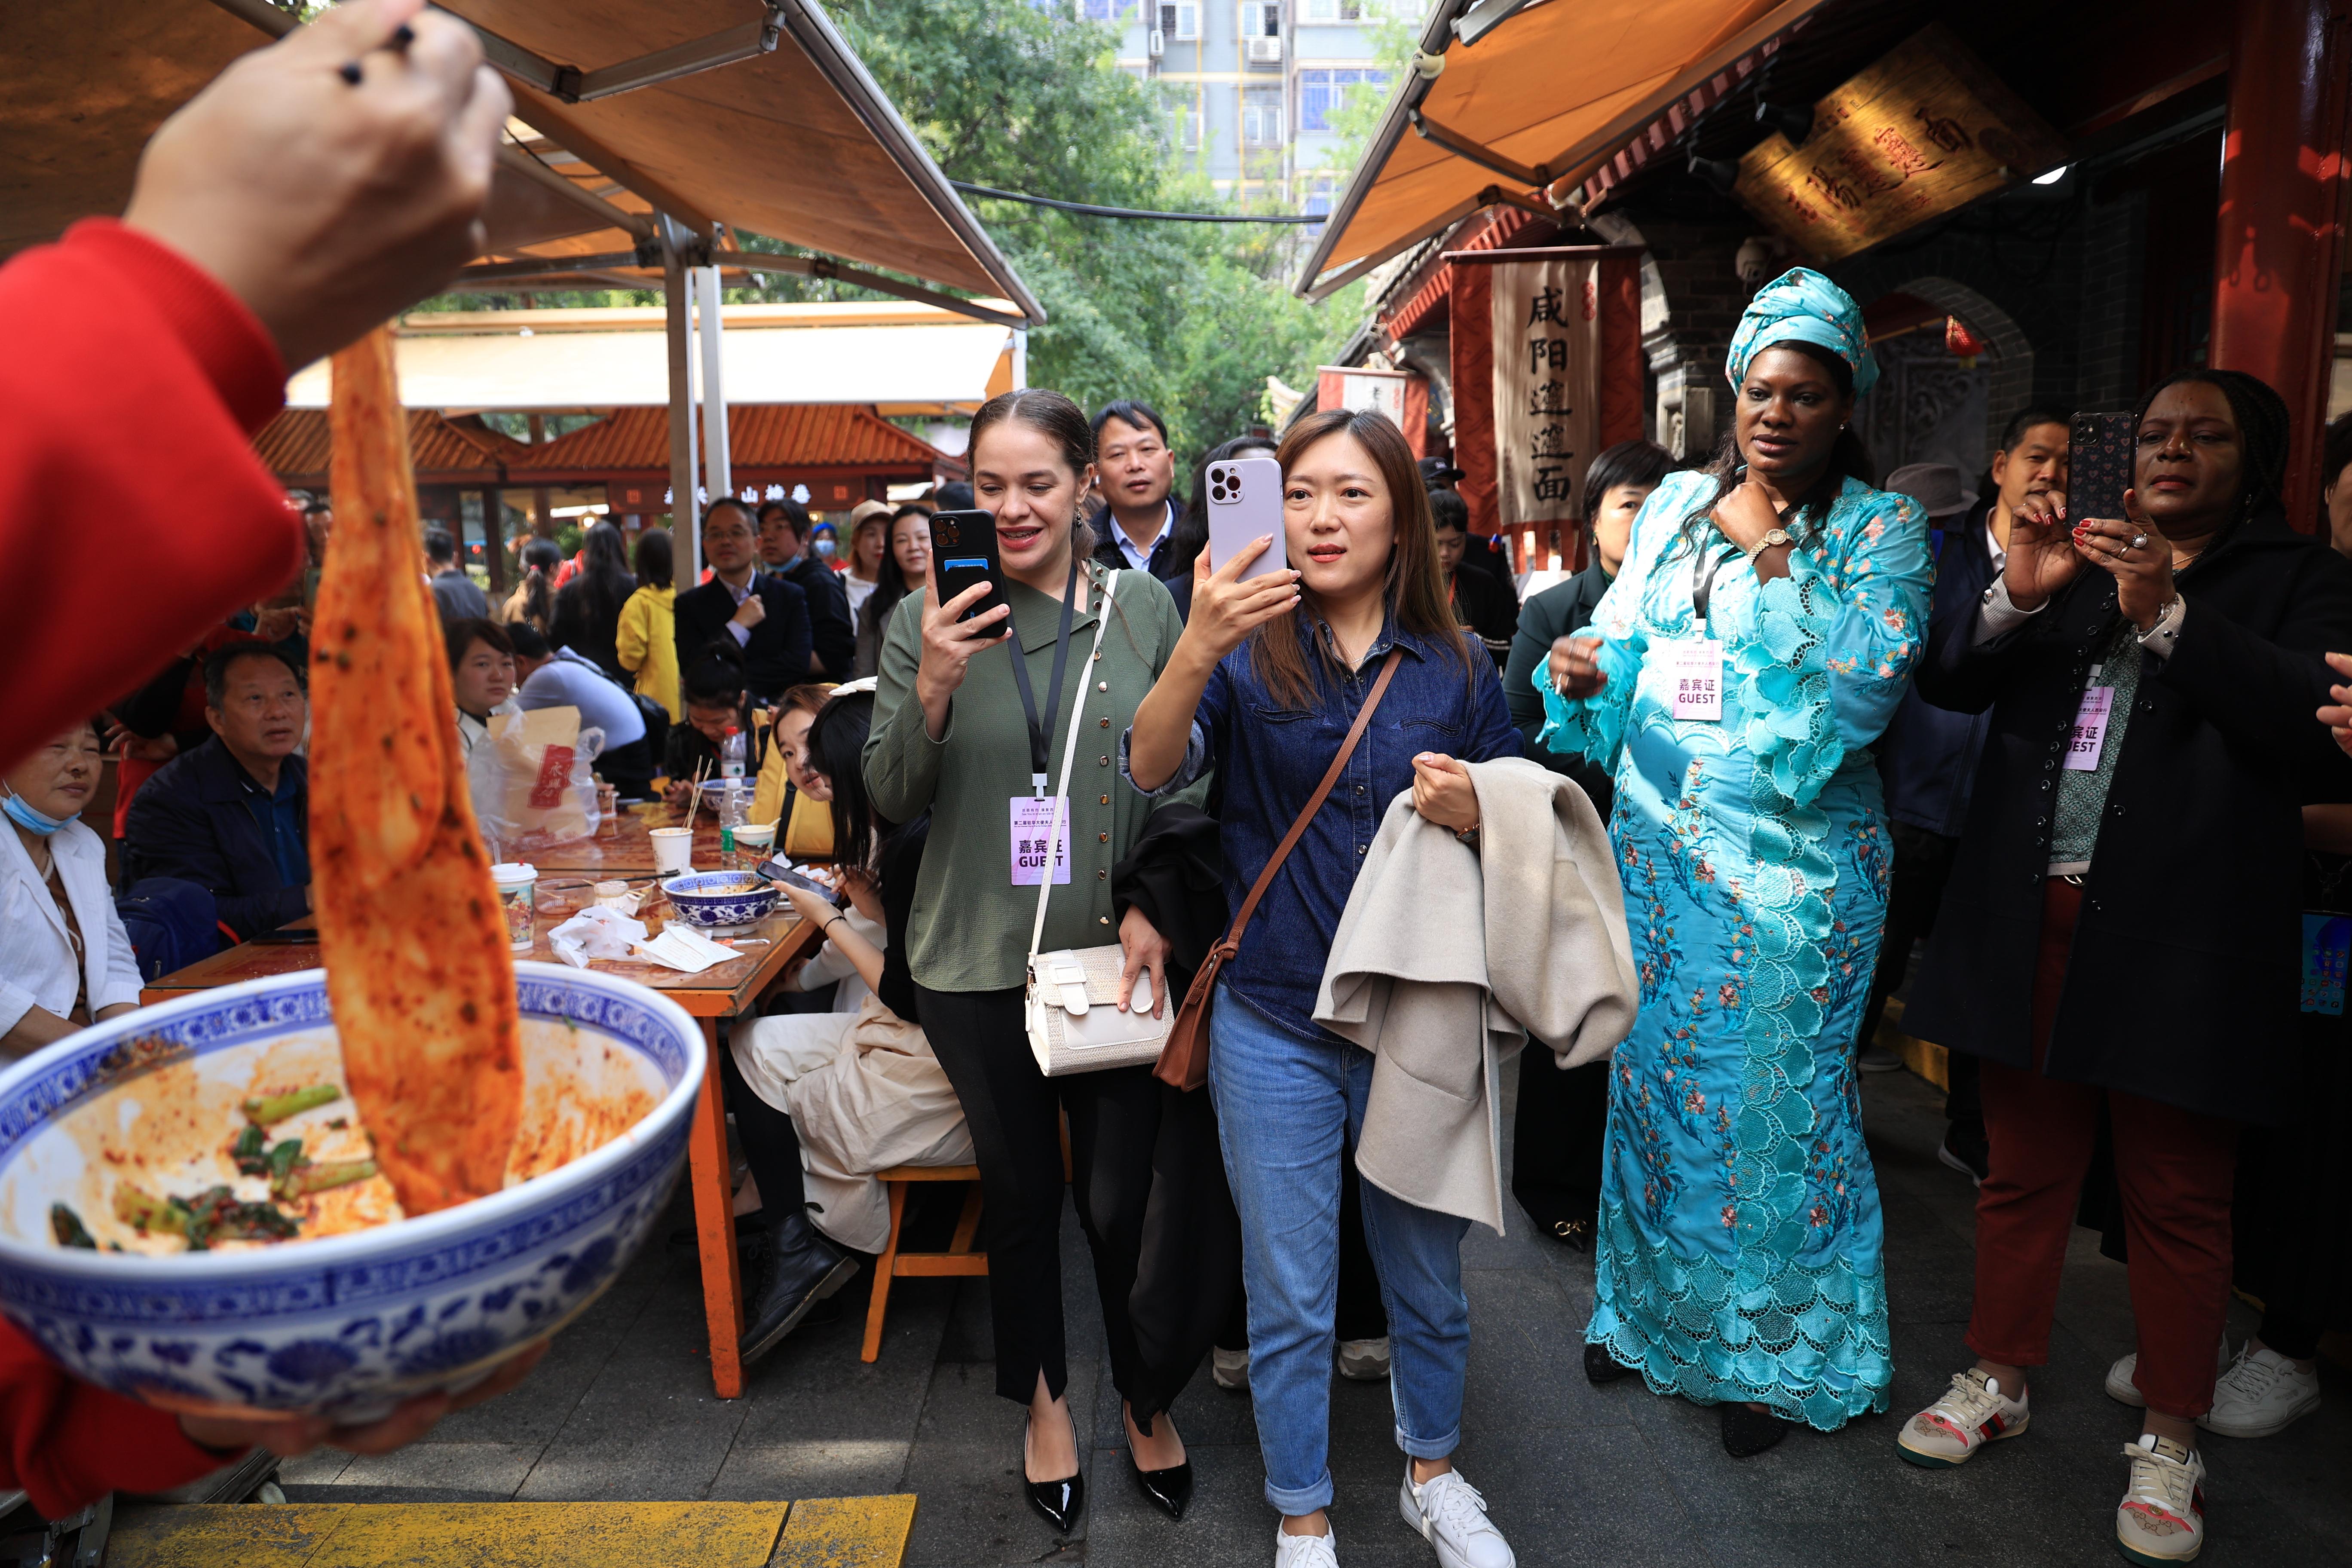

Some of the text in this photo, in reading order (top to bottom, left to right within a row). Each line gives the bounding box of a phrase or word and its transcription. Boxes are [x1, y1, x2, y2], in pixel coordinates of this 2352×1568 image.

[1679, 679, 1715, 691] 嘉宾证
[1679, 693, 1715, 704] GUEST
[2070, 726, 2098, 739] 宾证
[1019, 855, 1063, 867] GUET
